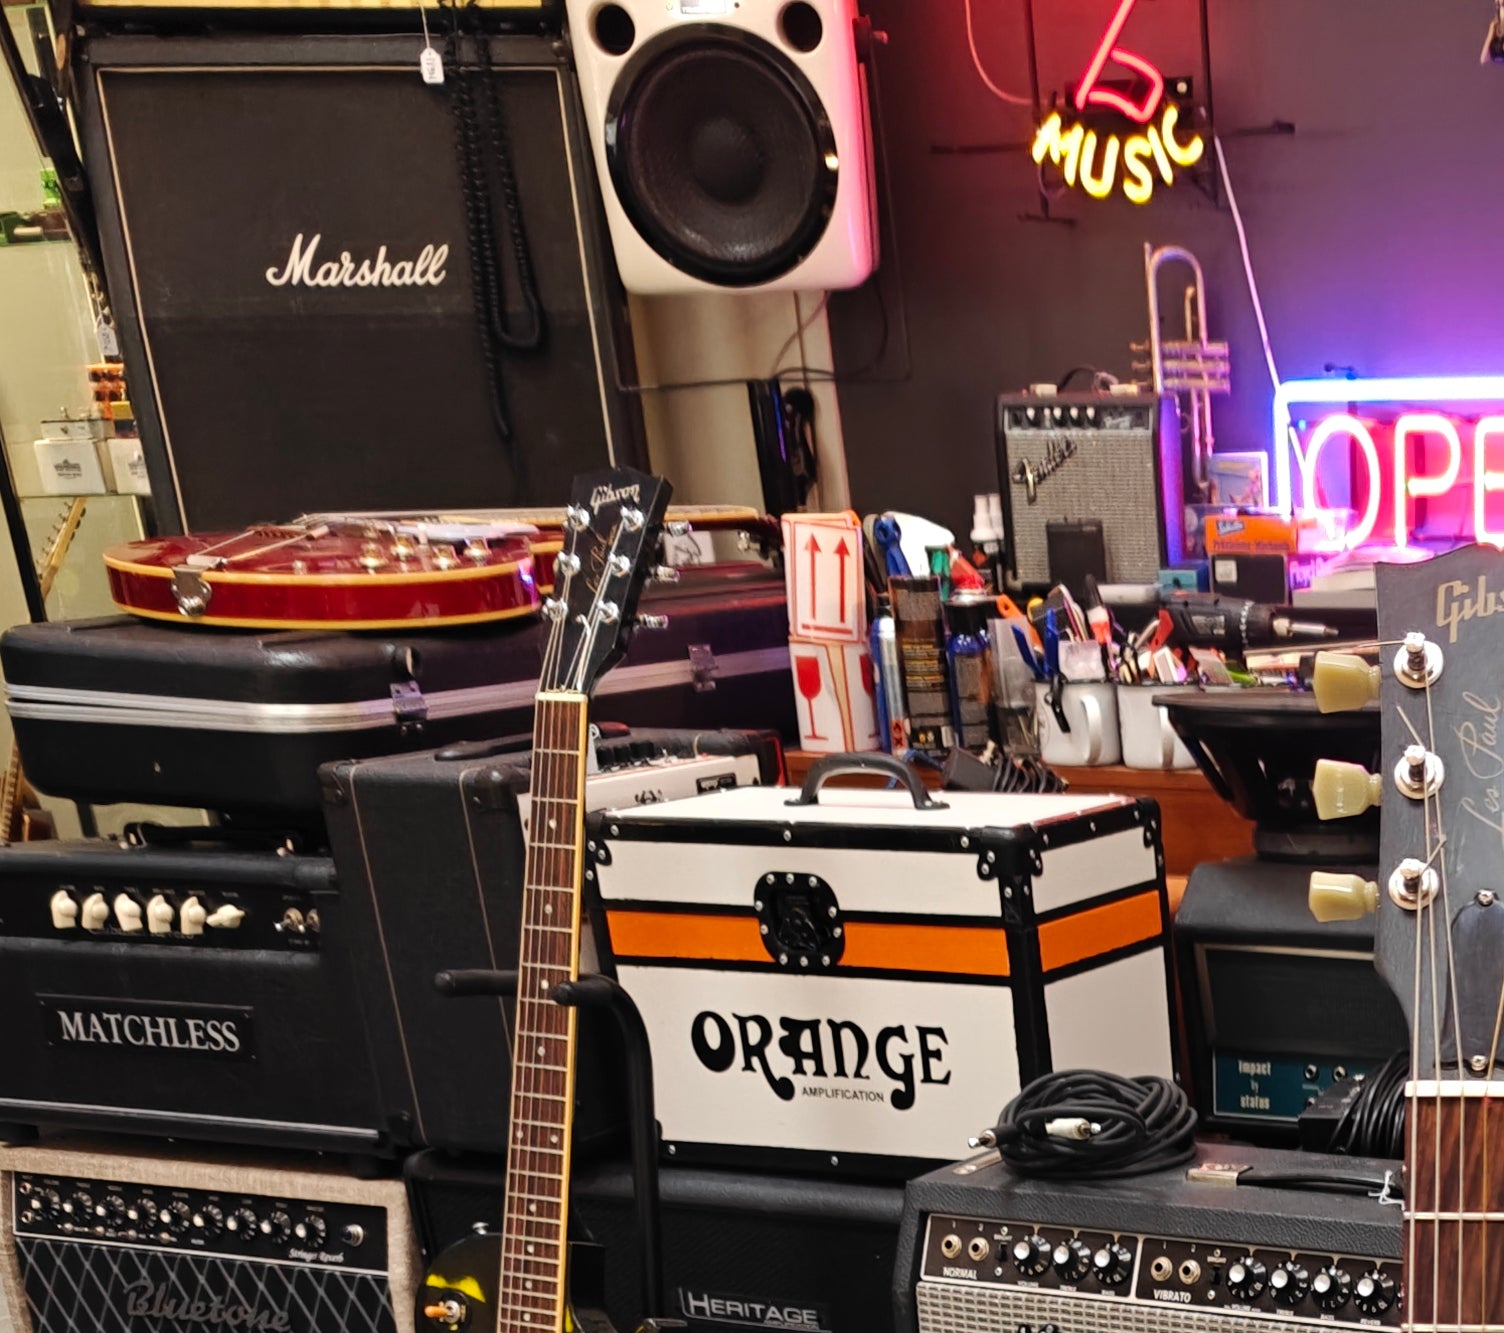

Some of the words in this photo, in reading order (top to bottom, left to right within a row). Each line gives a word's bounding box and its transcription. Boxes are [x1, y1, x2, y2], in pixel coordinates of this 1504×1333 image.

[1032, 104, 1204, 204] MUSIC
[266, 233, 450, 287] Marshall
[590, 483, 640, 516] Gibson
[1452, 690, 1504, 780] Paul
[57, 1010, 240, 1052] MATCHLESS
[691, 1010, 952, 1111] ORANGE
[1238, 1060, 1272, 1076] Impact
[802, 1086, 884, 1102] AMPLIFICATION
[1240, 1096, 1270, 1110] status
[943, 1267, 977, 1280] NORMAL
[122, 1278, 292, 1332] Bluetone
[687, 1290, 817, 1325] HERITAGE
[1153, 1289, 1192, 1304] VIBRATO
